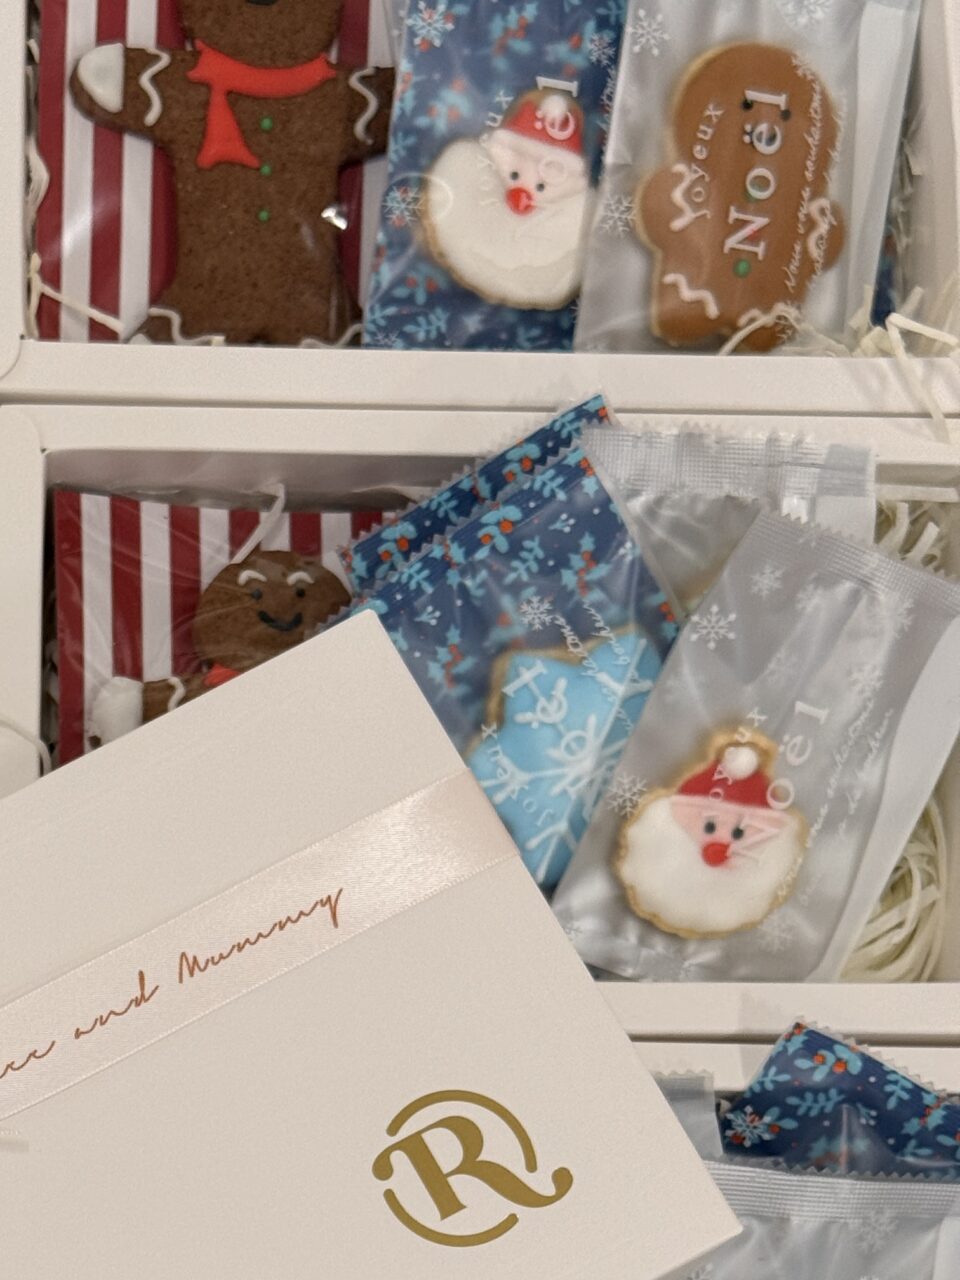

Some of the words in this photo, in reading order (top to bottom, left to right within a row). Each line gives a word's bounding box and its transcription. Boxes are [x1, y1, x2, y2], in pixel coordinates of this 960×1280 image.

[689, 103, 724, 219] Joyeux
[724, 89, 787, 261] Noël
[74, 970, 159, 1039] and
[178, 888, 343, 984] Mummy
[372, 1115, 574, 1221] R
